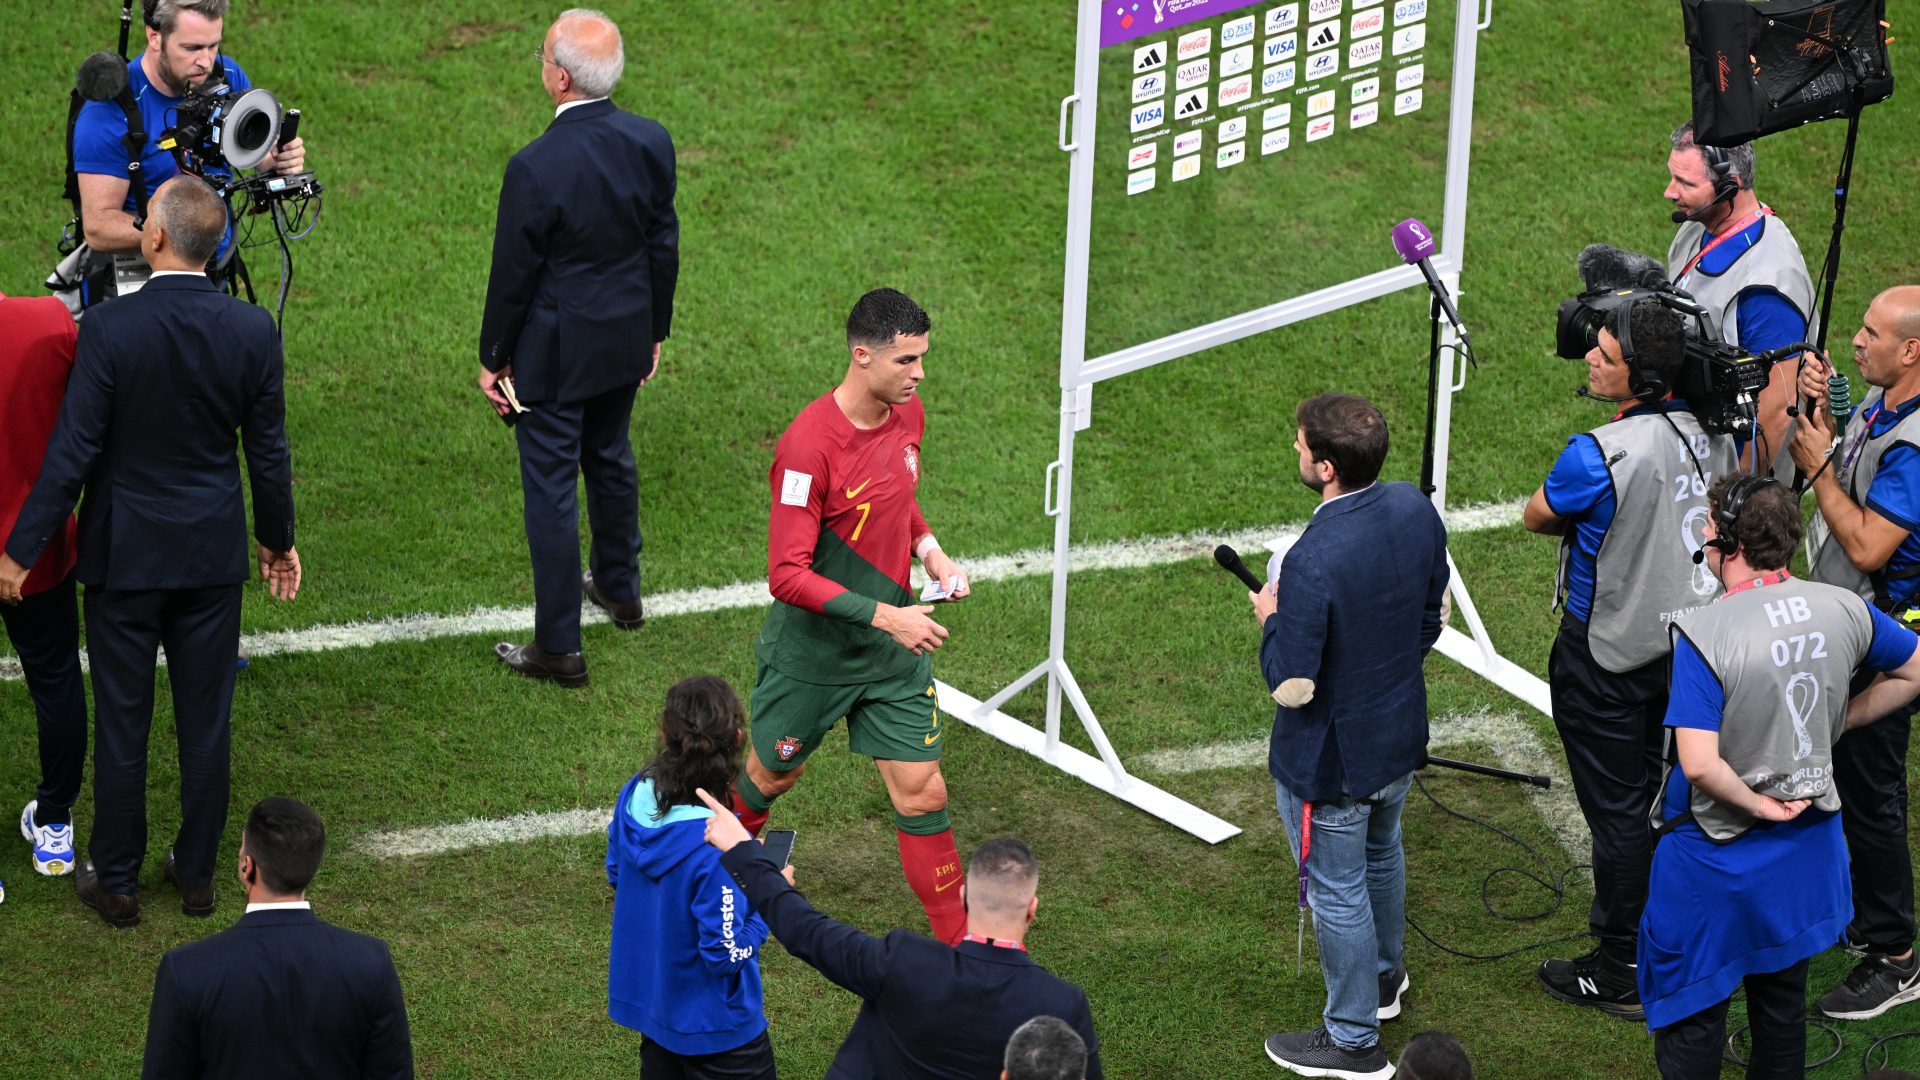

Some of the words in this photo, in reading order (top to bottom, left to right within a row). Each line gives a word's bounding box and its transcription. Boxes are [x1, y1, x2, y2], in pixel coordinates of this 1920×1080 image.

[1267, 40, 1295, 57] VISA
[1351, 42, 1380, 58] QATAR
[1178, 63, 1208, 80] QATAR
[1399, 73, 1421, 83] vivo
[1135, 87, 1162, 99] HYUNDAI
[1134, 107, 1162, 125] VISA
[1264, 136, 1287, 148] vivo
[850, 502, 871, 541] 7
[1660, 608, 1685, 622] FIFA
[1763, 596, 1812, 628] HB
[1770, 631, 1828, 668] 072
